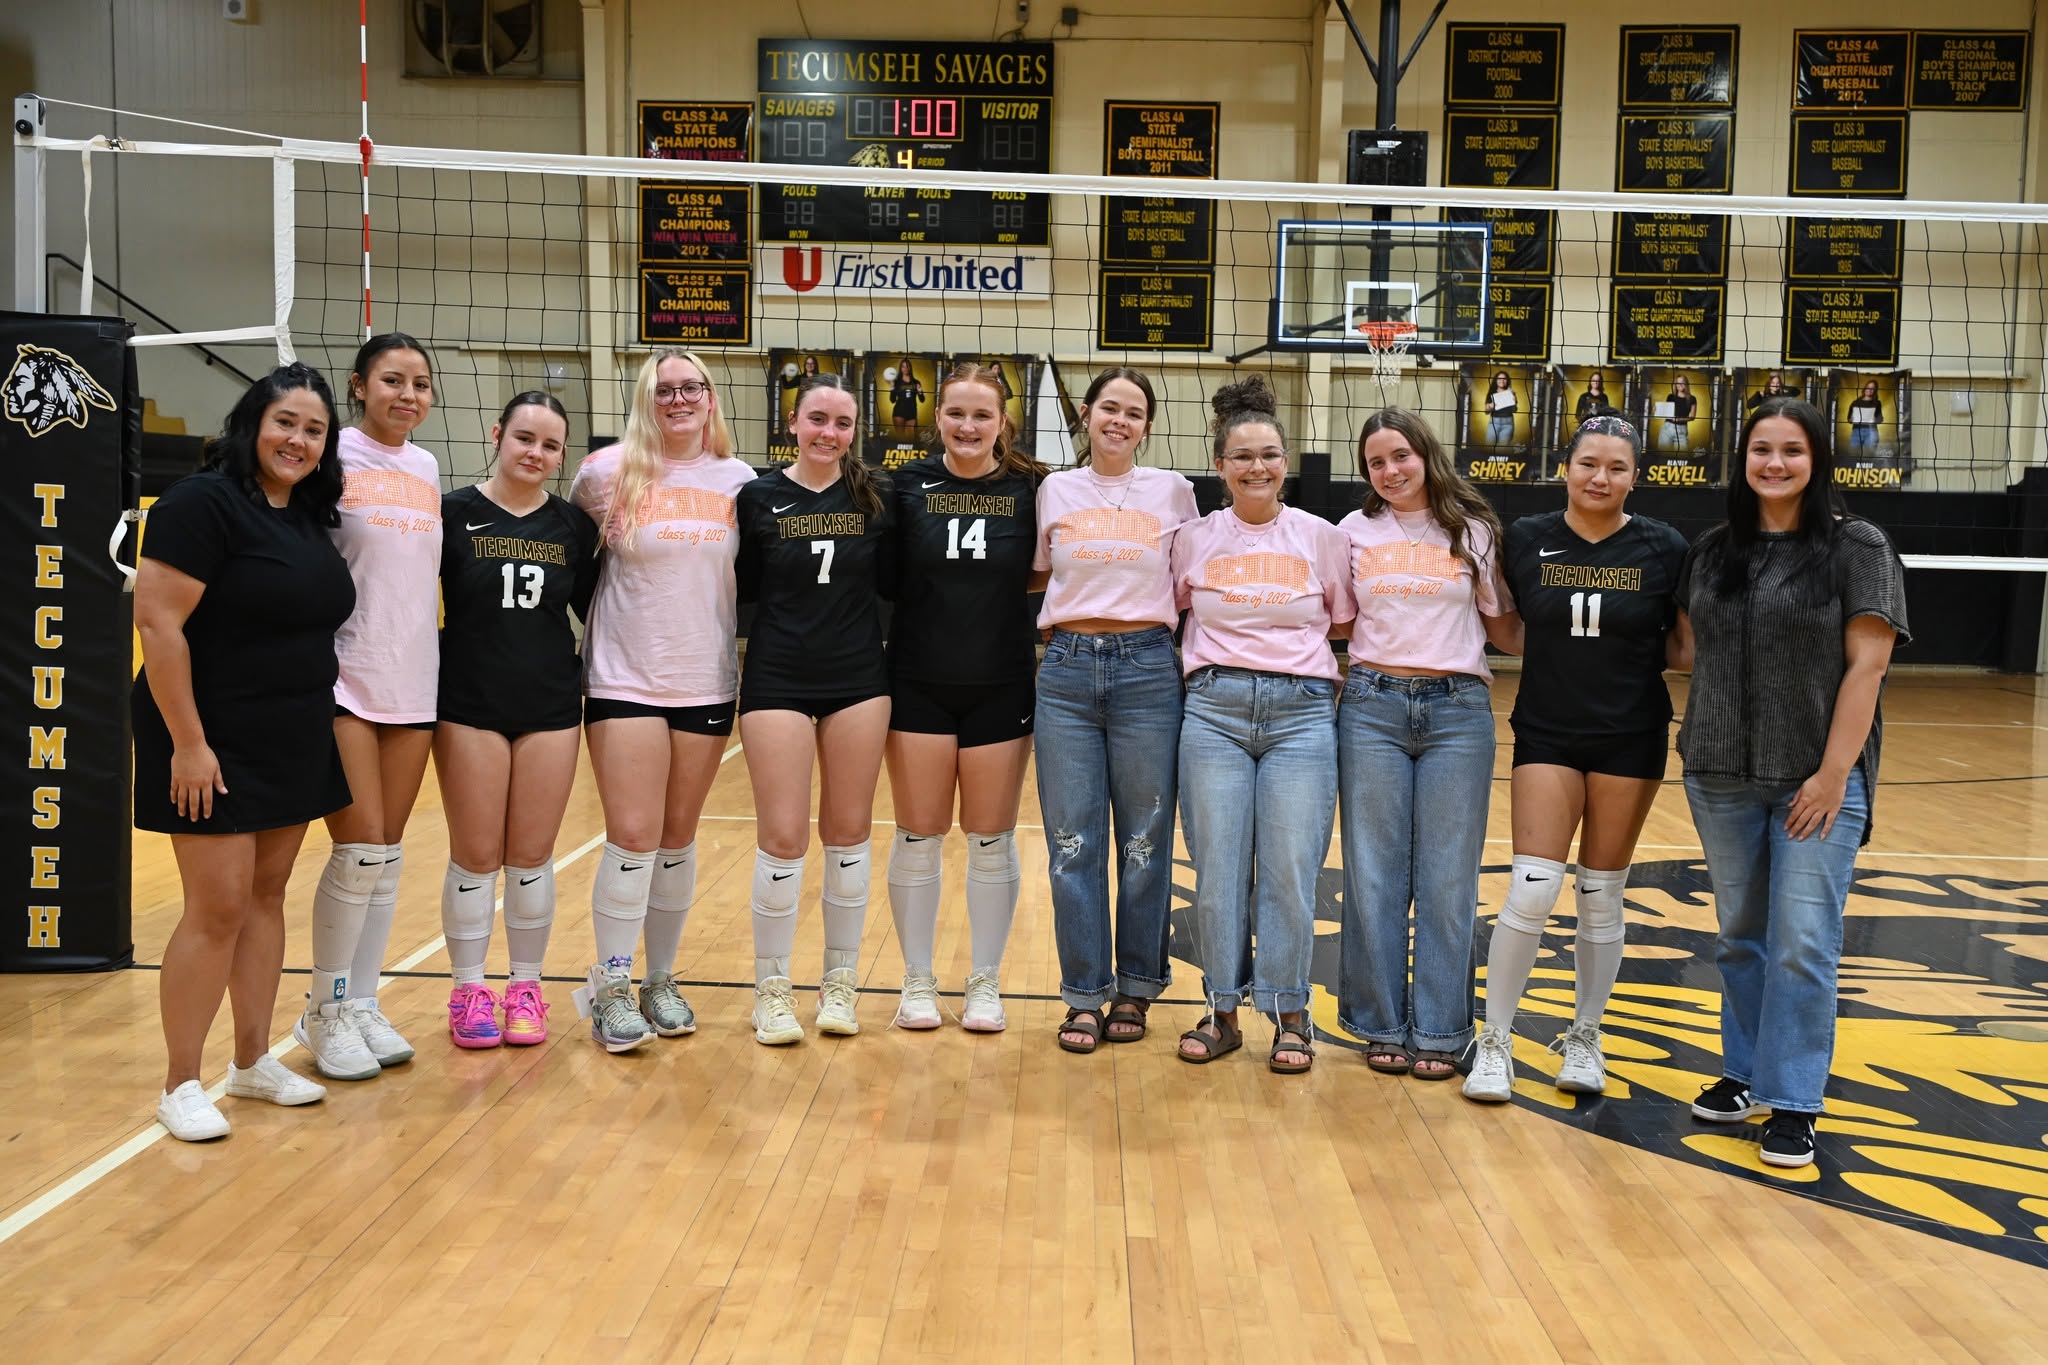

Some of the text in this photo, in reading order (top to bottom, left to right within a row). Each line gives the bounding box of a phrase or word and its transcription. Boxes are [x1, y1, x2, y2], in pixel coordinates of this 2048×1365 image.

[1488, 32, 1512, 46] CLASS
[1661, 34, 1683, 47] CLASS
[1827, 40, 1879, 51] CLASS 4A
[1944, 40, 1996, 50] CLASS 4A
[1468, 49, 1543, 64] DISTRICT CHAMPIONS
[1639, 52, 1658, 65] STATE
[1836, 52, 1870, 63] STATE
[1942, 50, 1998, 60] REGIONAL
[766, 51, 1047, 85] TECUMSEH SAVAGES
[1810, 65, 1894, 76] QUARTERFINALIST
[1922, 60, 2016, 70] BOY'S CHAMPION
[1486, 67, 1522, 81] FOOTBALL
[1667, 71, 1706, 84] BASKETBALL
[1920, 71, 2016, 80] STATE 3RD PLACE
[1823, 78, 1879, 89] BASEBALL
[1950, 81, 1986, 91] TRACK
[1838, 90, 1865, 102] 2012
[1955, 91, 1980, 102] 2007
[765, 99, 836, 117] SAVAGES
[981, 102, 1039, 119] VISITOR
[662, 110, 728, 122] CLASS 4A
[894, 99, 956, 136] 1:00
[1140, 111, 1185, 123] CLASS 4A
[674, 123, 718, 135] STATE
[1147, 123, 1177, 135] STATE
[1487, 119, 1508, 132] CLASS
[1658, 121, 1683, 134] CLASS
[1833, 122, 1854, 136] CLASS
[655, 136, 737, 148] CHAMPIONS
[1130, 136, 1194, 149] SEMIFINALIST
[1464, 136, 1540, 150] STATE QUARTERFINALIST
[1639, 138, 1713, 152] STATE SEMIFINALIST
[1811, 140, 1886, 154] STATE QUARTERFINALIST
[897, 149, 912, 169] 4
[1118, 148, 1204, 161] BOYS BASKETBALL
[1485, 154, 1516, 168] FOOTBALL
[917, 157, 945, 166] PERIOD
[1150, 161, 1172, 173] 2011
[1646, 156, 1704, 169] BOYS BASKETBALL
[1832, 157, 1863, 171] BASEBALL
[667, 193, 723, 205] CLASS 4A
[782, 185, 1027, 200] FOULS PLAYER FOULS FOULS
[677, 207, 713, 218] STATE
[1122, 210, 1140, 223] STATE
[660, 219, 731, 231] CHAMPIONS
[1494, 221, 1535, 235] CHAMPIONS
[1634, 223, 1708, 238] STATE SEMIFINALIST
[653, 231, 737, 243] WIN WIN WEEK
[789, 230, 809, 239] WON
[901, 232, 925, 241] GAME
[998, 233, 1018, 243] WON
[1127, 228, 1186, 242] BOYS BASKETBALL
[1808, 225, 1883, 239] STATE QUARTERFINALIST
[680, 245, 709, 256] 2012
[1641, 241, 1699, 255] BOYS BASKETBALL
[1830, 242, 1860, 256] BASEBALL
[835, 254, 1024, 291] FirstUnited
[667, 275, 724, 286] CLASS 5A
[1141, 278, 1162, 290] CLASS
[677, 287, 713, 298] STATE
[1654, 290, 1676, 304] CLASS
[660, 299, 731, 311] CHAMPIONS
[1120, 294, 1138, 307] STATE
[1822, 293, 1864, 306] CLASS 2A
[652, 313, 737, 325] WIN WIN WEEK
[1140, 312, 1171, 326] FOOTBALL
[1805, 309, 1880, 324] STATE RUNNER-UP
[682, 326, 709, 337] 2011
[1637, 325, 1696, 339] BOYS BASKETBALL
[1820, 327, 1862, 340] BASEBALL
[882, 449, 928, 466] JONES
[1469, 461, 1526, 478] SHIREY
[1647, 465, 1707, 482] SEWELL
[1832, 467, 1902, 484] JOHNSON
[926, 493, 1015, 517] TECUMSEH
[366, 510, 436, 535] class of 2027
[776, 513, 865, 538] TECUMSEH
[656, 524, 727, 546] class of 2027
[946, 518, 987, 559] 14
[471, 536, 568, 566] TECUMSEH
[1071, 544, 1144, 565] class of 2027
[811, 540, 835, 584] 7
[1541, 563, 1641, 591] TECUMSEH
[501, 562, 545, 609] 13
[1369, 579, 1444, 600] class of 2027
[1221, 589, 1292, 609] class of 2027
[1570, 592, 1602, 637] 11
[27, 483, 67, 949] TECUMSEH
